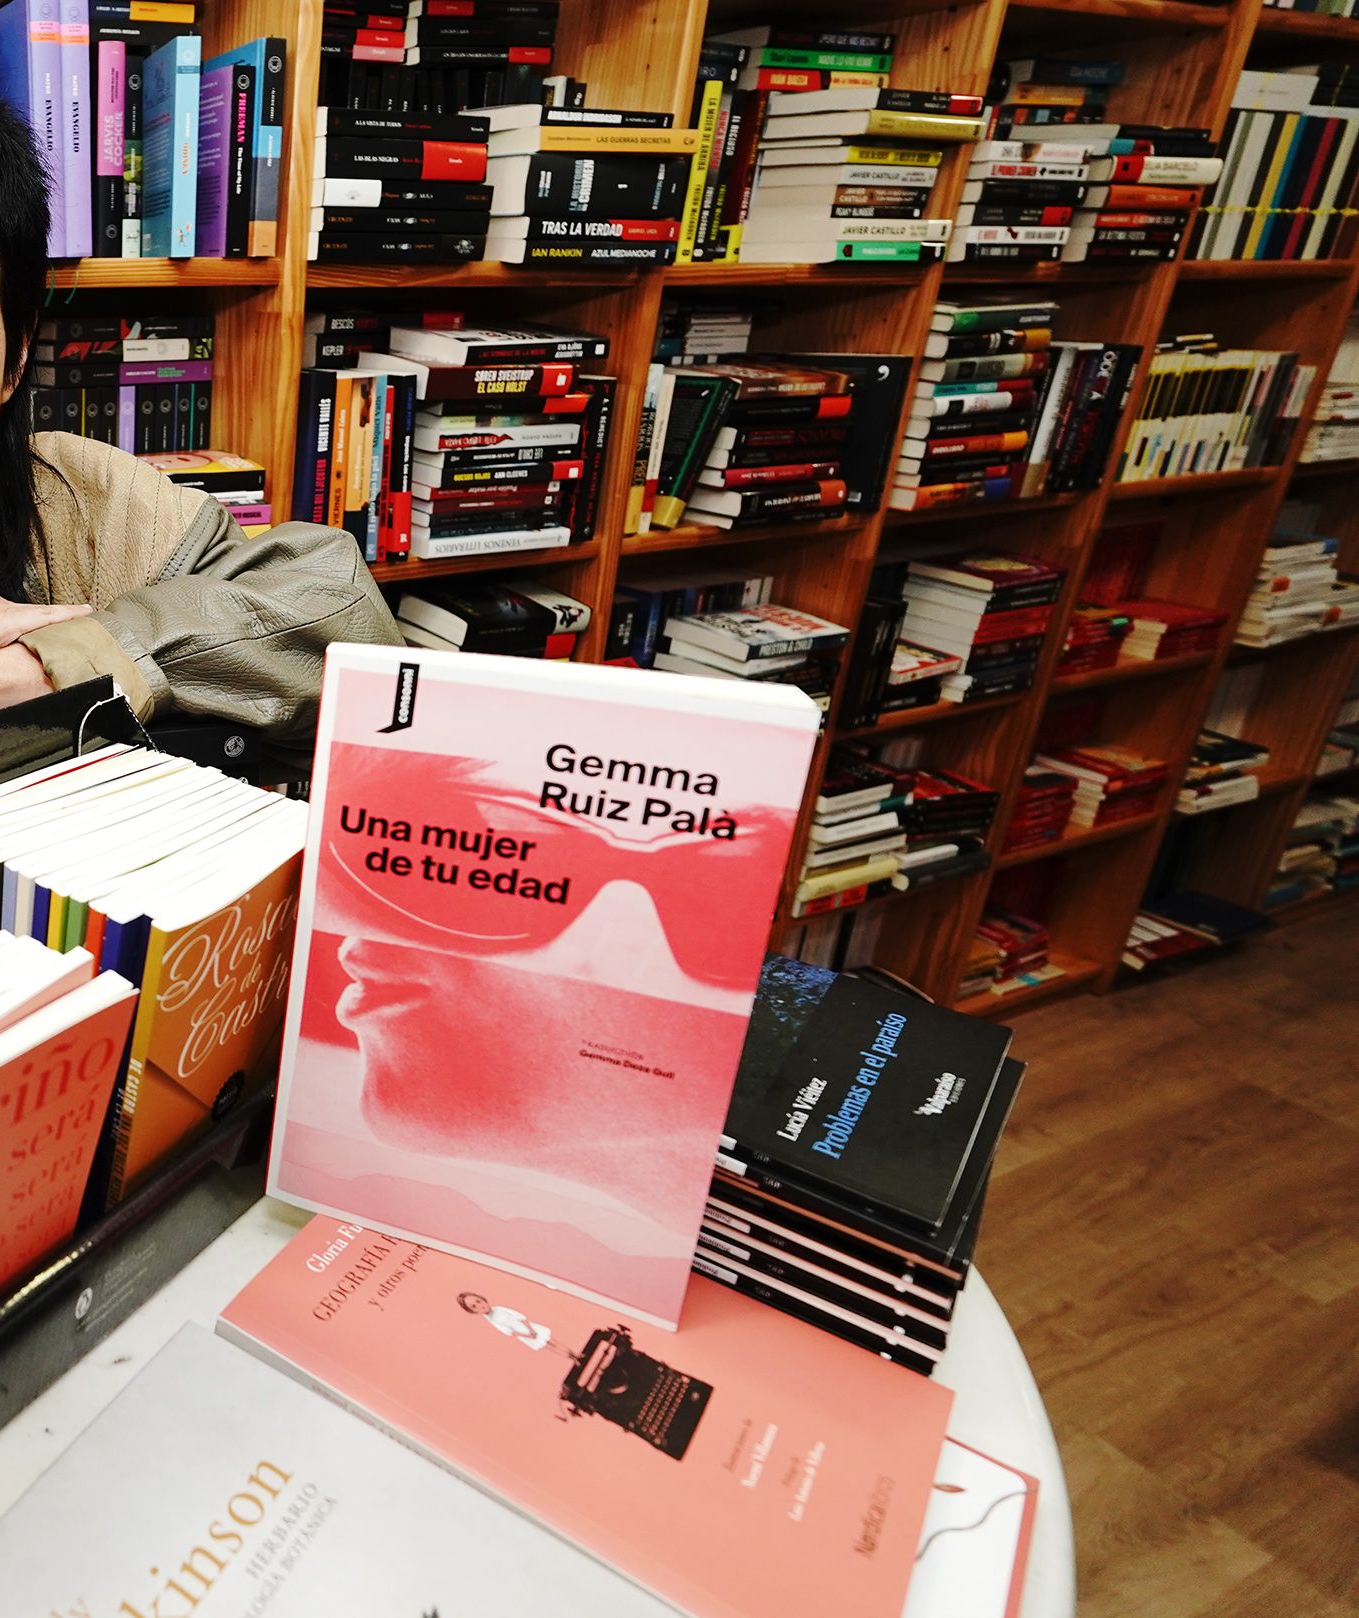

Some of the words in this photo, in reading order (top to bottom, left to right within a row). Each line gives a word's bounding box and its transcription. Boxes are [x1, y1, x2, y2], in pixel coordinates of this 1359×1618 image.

[45, 99, 53, 152] EVANGELIO
[238, 92, 247, 142] FREEMAN
[103, 114, 115, 162] JARVIS
[113, 111, 123, 166] COCKER
[596, 136, 610, 144] LAS
[640, 137, 672, 145] SECRETAS
[578, 159, 595, 203] CRIMEN
[542, 221, 568, 235] TRAS
[569, 222, 583, 235] LA
[585, 222, 623, 237] VERDAD
[842, 226, 868, 234] JAVIER
[870, 226, 906, 234] CASTILLO
[531, 248, 548, 257] IAN
[549, 248, 583, 257] RANKIN
[591, 248, 610, 257] AZUL
[610, 249, 657, 258] MEDIANOCHE
[322, 344, 344, 356] KEPLER
[477, 381, 486, 394] EL
[486, 381, 505, 394] CASO
[505, 380, 527, 393] HOLST
[497, 369, 534, 381] SVEISTRUP
[318, 398, 332, 424] VALLÉS
[317, 423, 330, 453] VICENTE
[517, 449, 534, 460] CHILD
[534, 448, 544, 459] LEE
[453, 474, 474, 482] HUESOS
[494, 471, 506, 479] ANN
[506, 469, 528, 478] CLEEVES
[313, 503, 323, 523] CAZA
[333, 488, 342, 527] VIERNES
[435, 541, 482, 553] LITERARIOS
[483, 538, 521, 551] VENENOS
[759, 640, 789, 657] PRESTON
[793, 637, 814, 651] CHILD
[396, 667, 416, 725] consonni
[545, 743, 721, 796] Gemma
[539, 781, 631, 822] Ruiz
[641, 799, 739, 842] Palà
[340, 805, 411, 843] Una
[421, 820, 537, 861] mujer
[365, 847, 413, 877] de
[420, 856, 457, 886] tu
[468, 866, 573, 905] edad
[240, 950, 263, 994] de
[177, 952, 290, 1079] Castr
[871, 1012, 908, 1059] paraíso
[129, 1057, 143, 1070] DE
[579, 1049, 620, 1066] Gemma
[855, 1064, 879, 1087] en
[863, 1046, 882, 1068] el
[122, 1070, 141, 1115] CASTRO
[12, 1083, 100, 1160] será
[776, 1108, 810, 1142] Lucía
[811, 1083, 872, 1160] Problemas
[12, 1131, 88, 1201] será
[305, 1235, 350, 1274] Gloria
[311, 1242, 390, 1323] GEOGRAFÍA
[367, 1297, 384, 1312] y
[378, 1268, 409, 1304] otros
[245, 1481, 320, 1580] HERBARIO
[285, 1494, 339, 1576] BOTÁNICA
